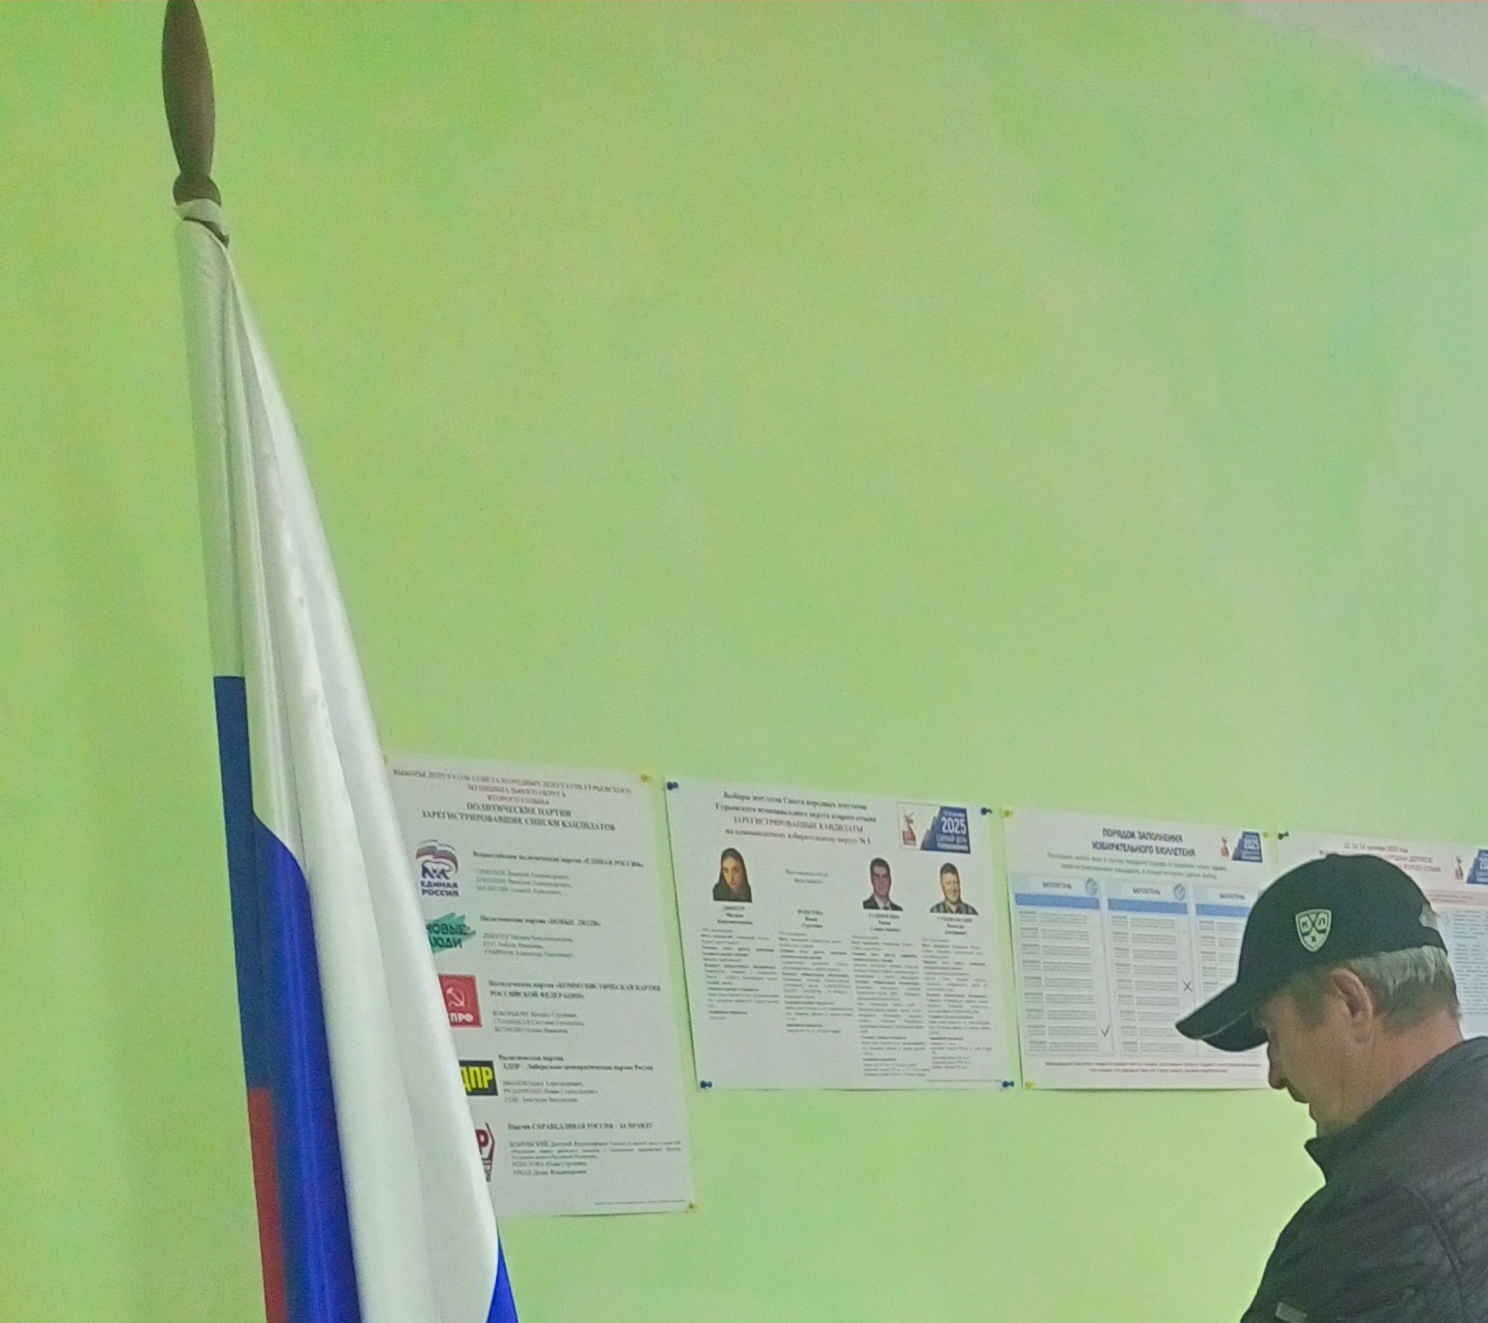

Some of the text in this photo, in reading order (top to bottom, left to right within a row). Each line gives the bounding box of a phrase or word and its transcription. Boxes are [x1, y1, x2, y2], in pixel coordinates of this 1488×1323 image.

[941, 816, 967, 835] 2025
[1102, 828, 1136, 840] ПОРЯДОК
[1244, 839, 1260, 850] 2025
[422, 889, 459, 897] РОССИЯ
[448, 1012, 474, 1023] ПРФ
[460, 1065, 493, 1092] ДПР
